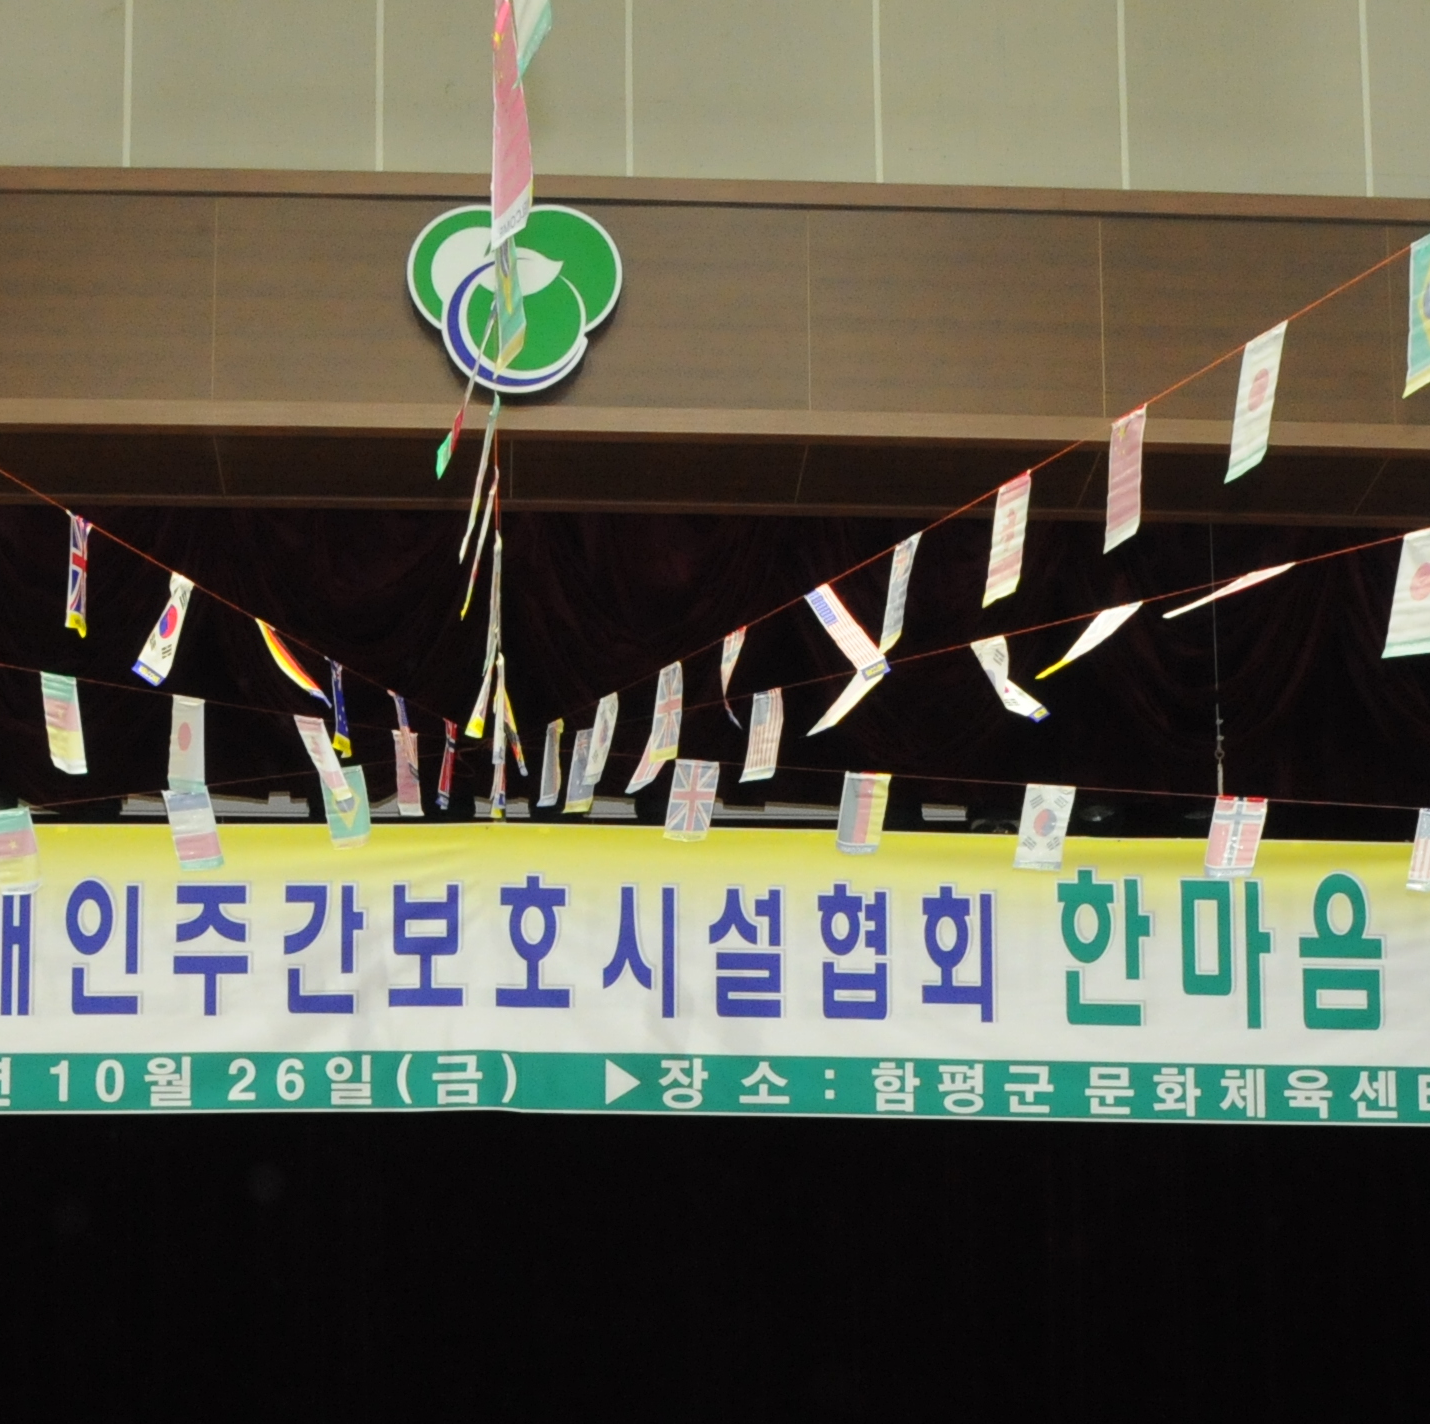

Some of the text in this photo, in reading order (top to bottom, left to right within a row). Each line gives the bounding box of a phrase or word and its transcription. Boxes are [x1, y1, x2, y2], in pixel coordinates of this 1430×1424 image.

[1057, 870, 1383, 1030] 한마음
[49, 1057, 192, 1107] 10월
[871, 1062, 1055, 1116] 함평군
